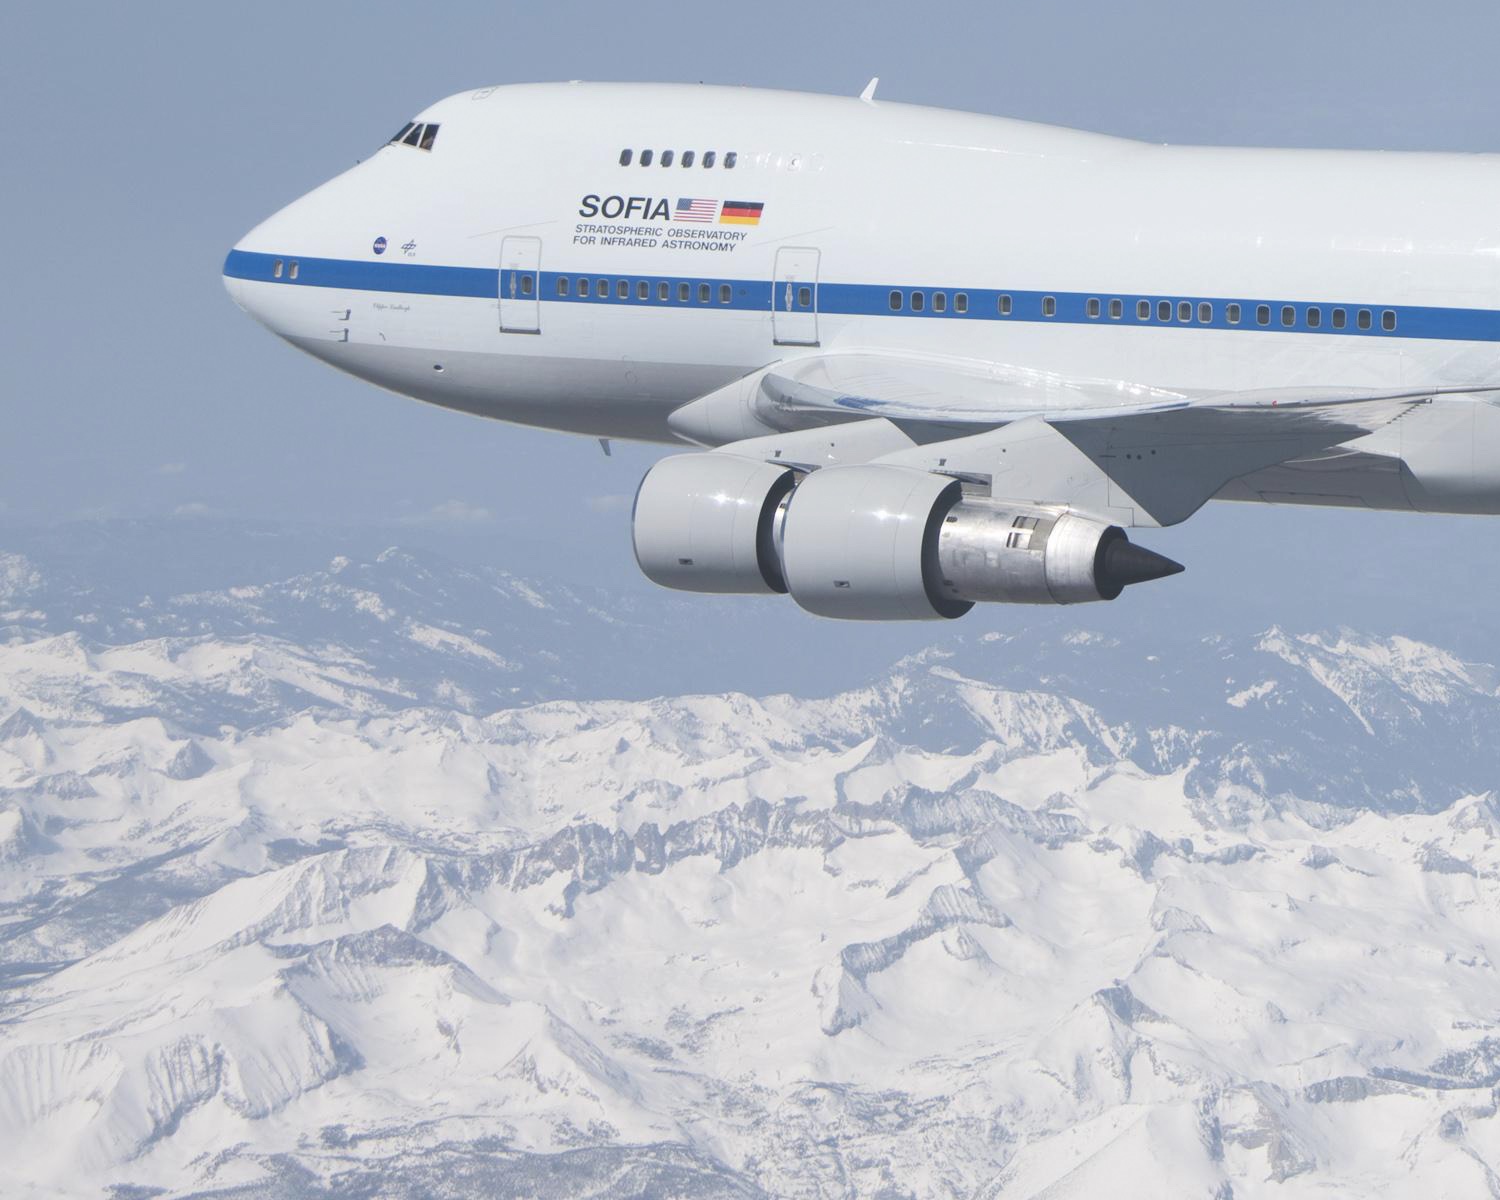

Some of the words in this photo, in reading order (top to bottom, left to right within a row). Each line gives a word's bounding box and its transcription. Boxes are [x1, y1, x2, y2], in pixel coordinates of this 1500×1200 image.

[579, 194, 670, 220] SOFIA
[575, 224, 663, 237] STRATOSPHERIC
[667, 228, 747, 241] OBSERVATORY
[573, 235, 596, 245] FOR
[600, 237, 657, 248] INFRARED
[662, 240, 736, 252] ASTRONOMY
